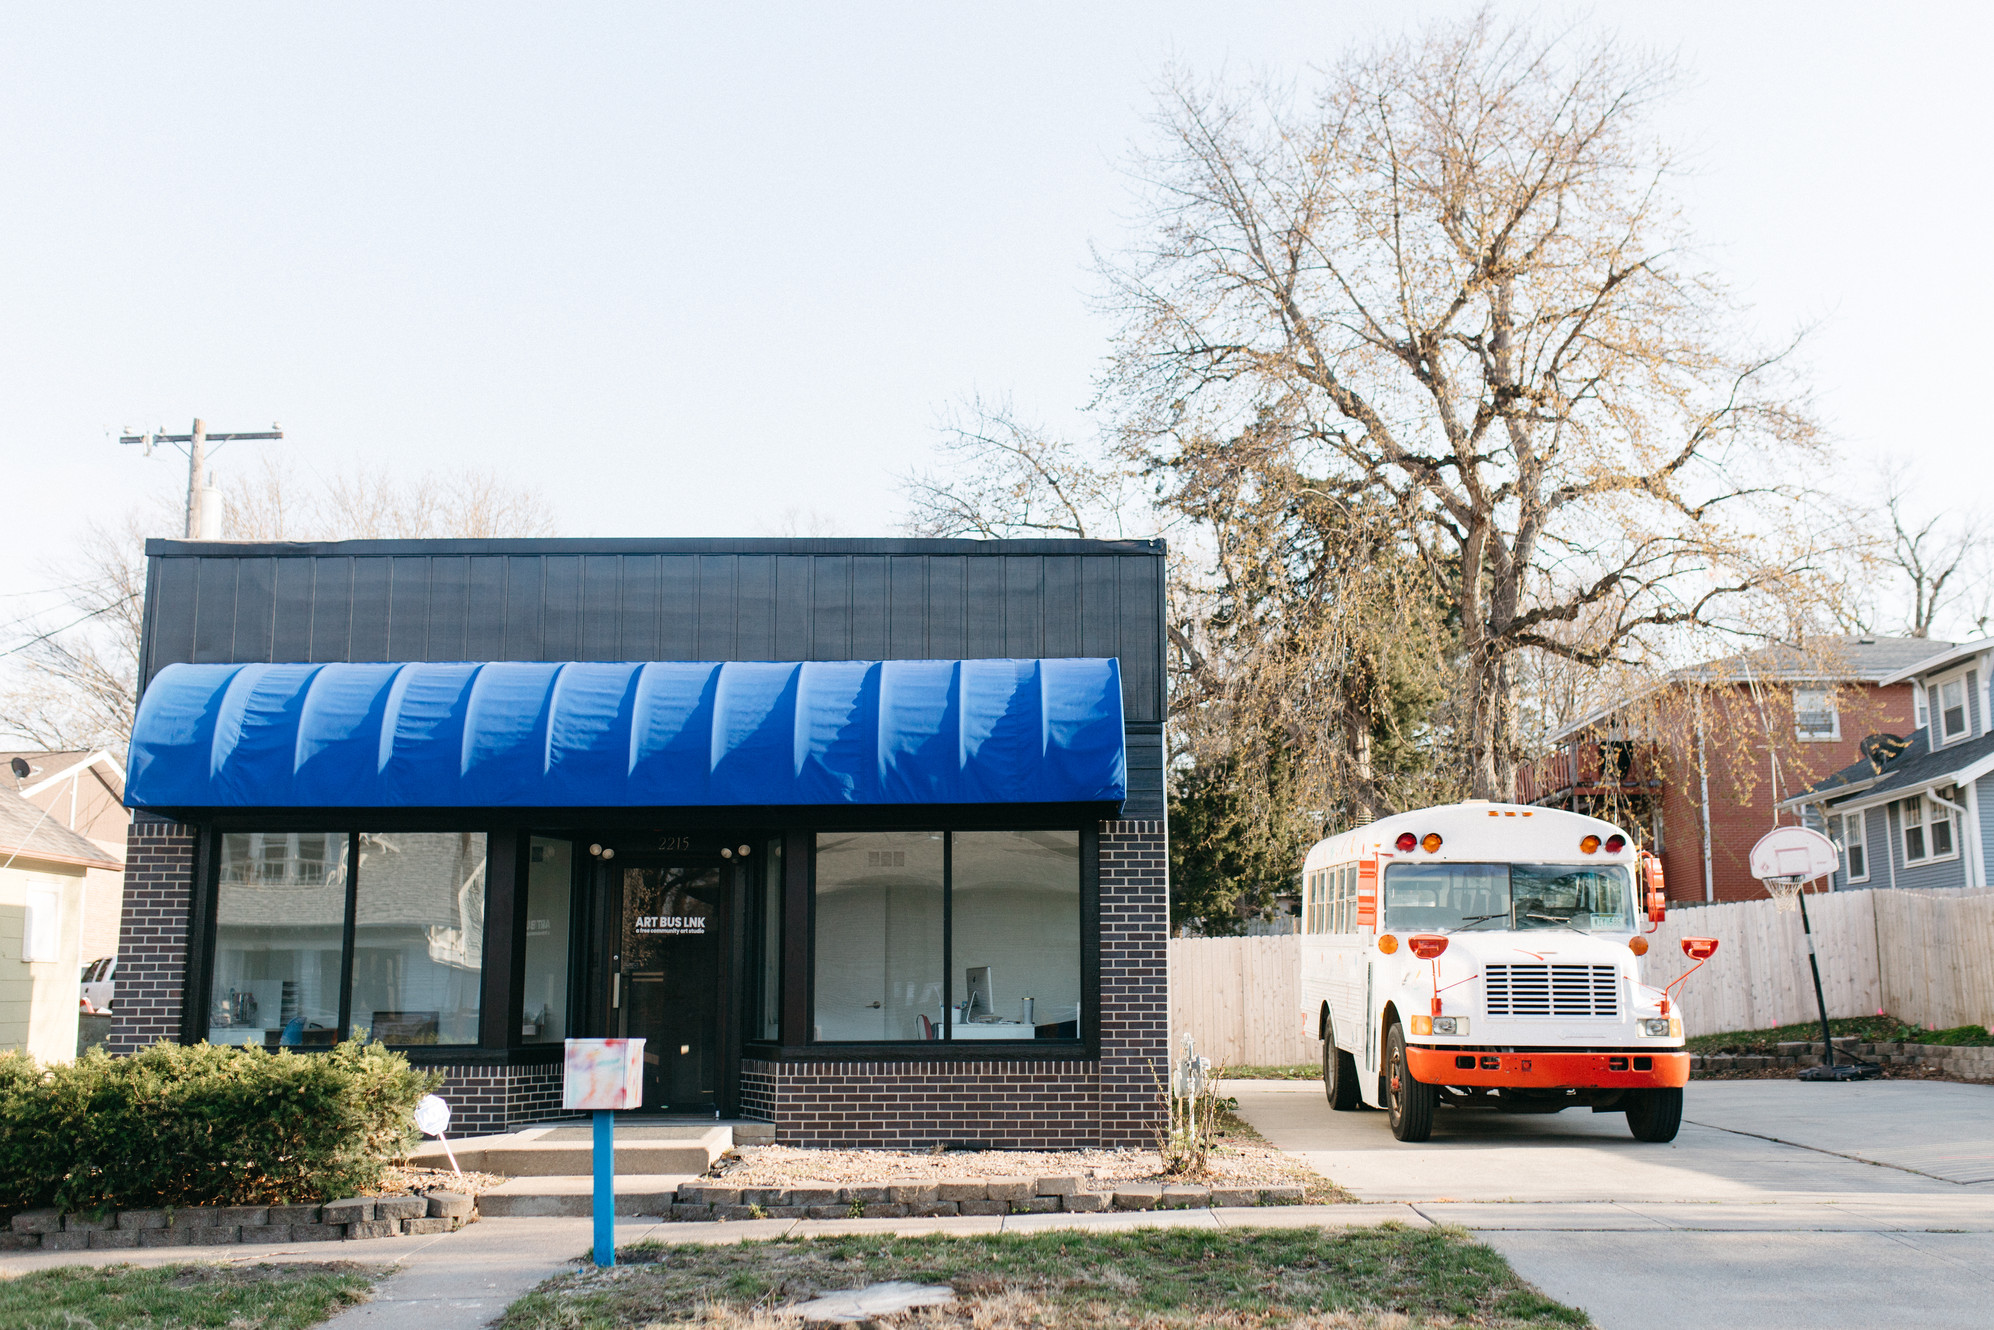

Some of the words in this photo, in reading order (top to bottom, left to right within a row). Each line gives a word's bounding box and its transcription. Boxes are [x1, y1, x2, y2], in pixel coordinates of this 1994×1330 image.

[658, 836, 690, 851] 2215
[635, 916, 658, 928] ART
[659, 916, 682, 928] BUS
[683, 916, 706, 928] LNK
